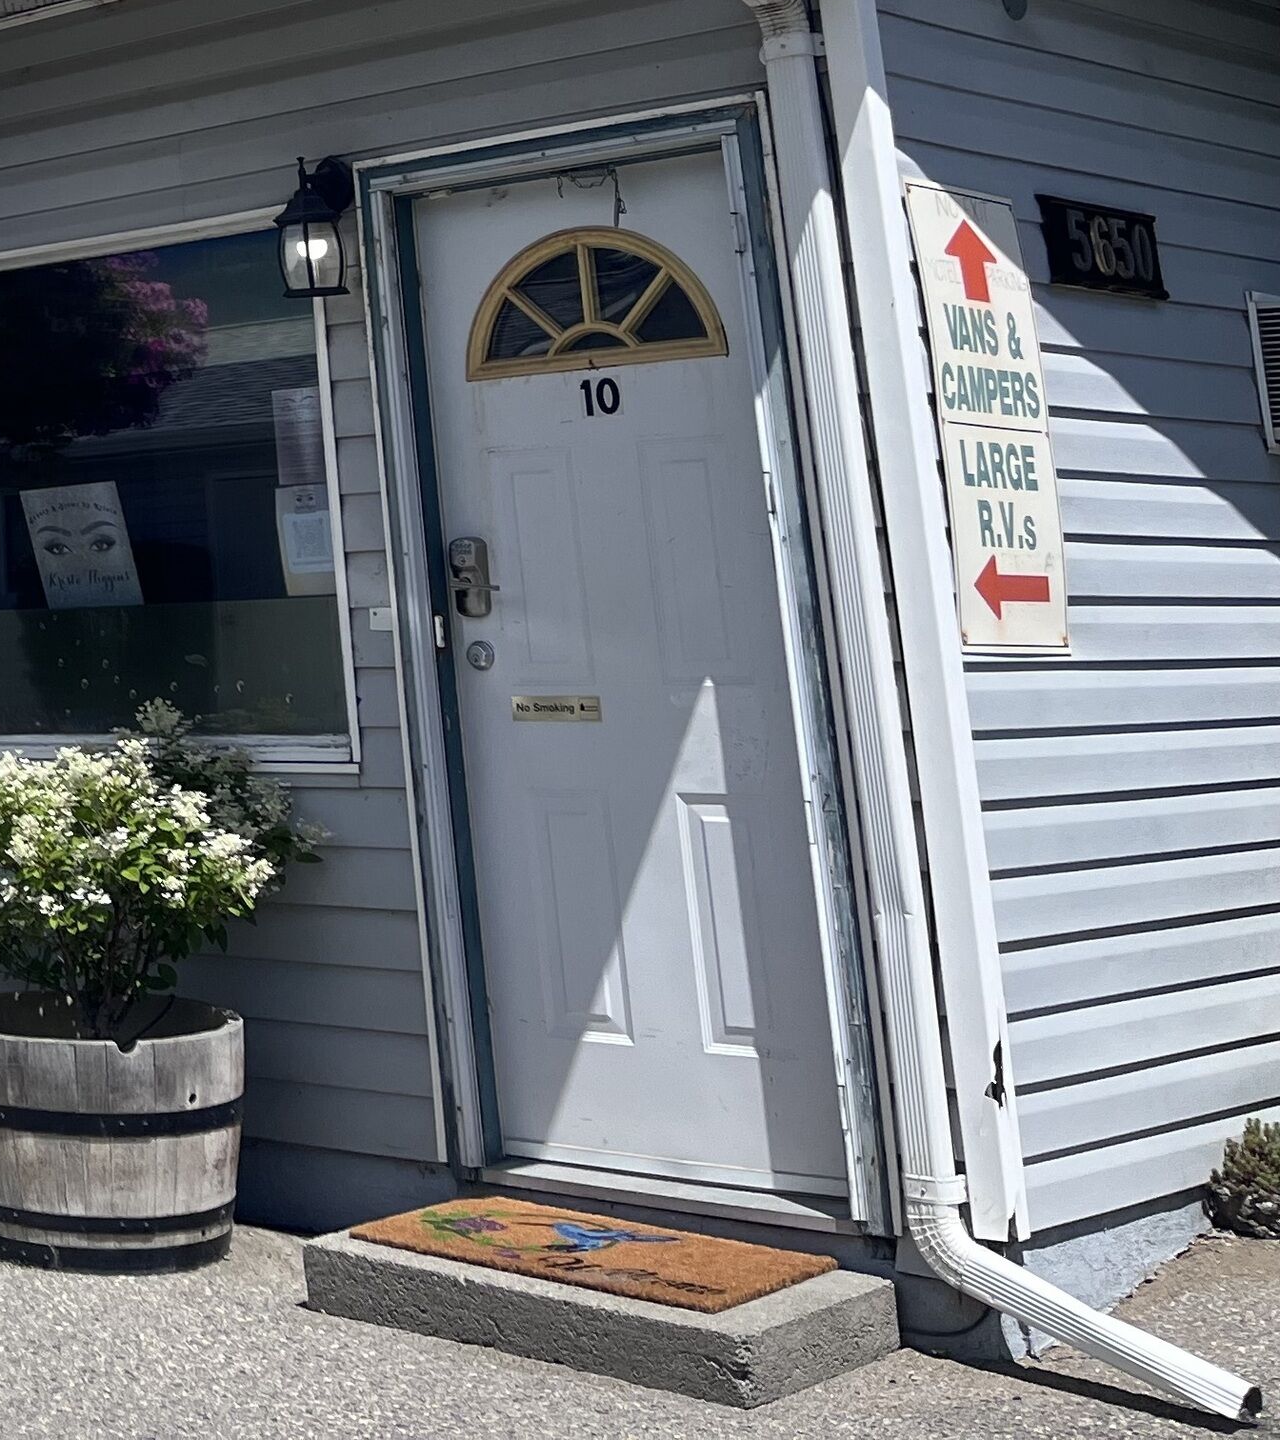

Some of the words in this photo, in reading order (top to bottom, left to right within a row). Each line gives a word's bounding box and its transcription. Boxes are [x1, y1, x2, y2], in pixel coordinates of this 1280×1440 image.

[1066, 208, 1153, 282] 5650
[942, 303, 999, 357] VANS
[1006, 311, 1024, 360] &
[579, 377, 620, 417] 10
[941, 361, 1041, 419] CAMPERS
[959, 439, 1039, 492] LARGE
[977, 499, 1037, 551] R.V.s
[516, 703, 531, 713] No
[533, 702, 575, 715] Smoking
